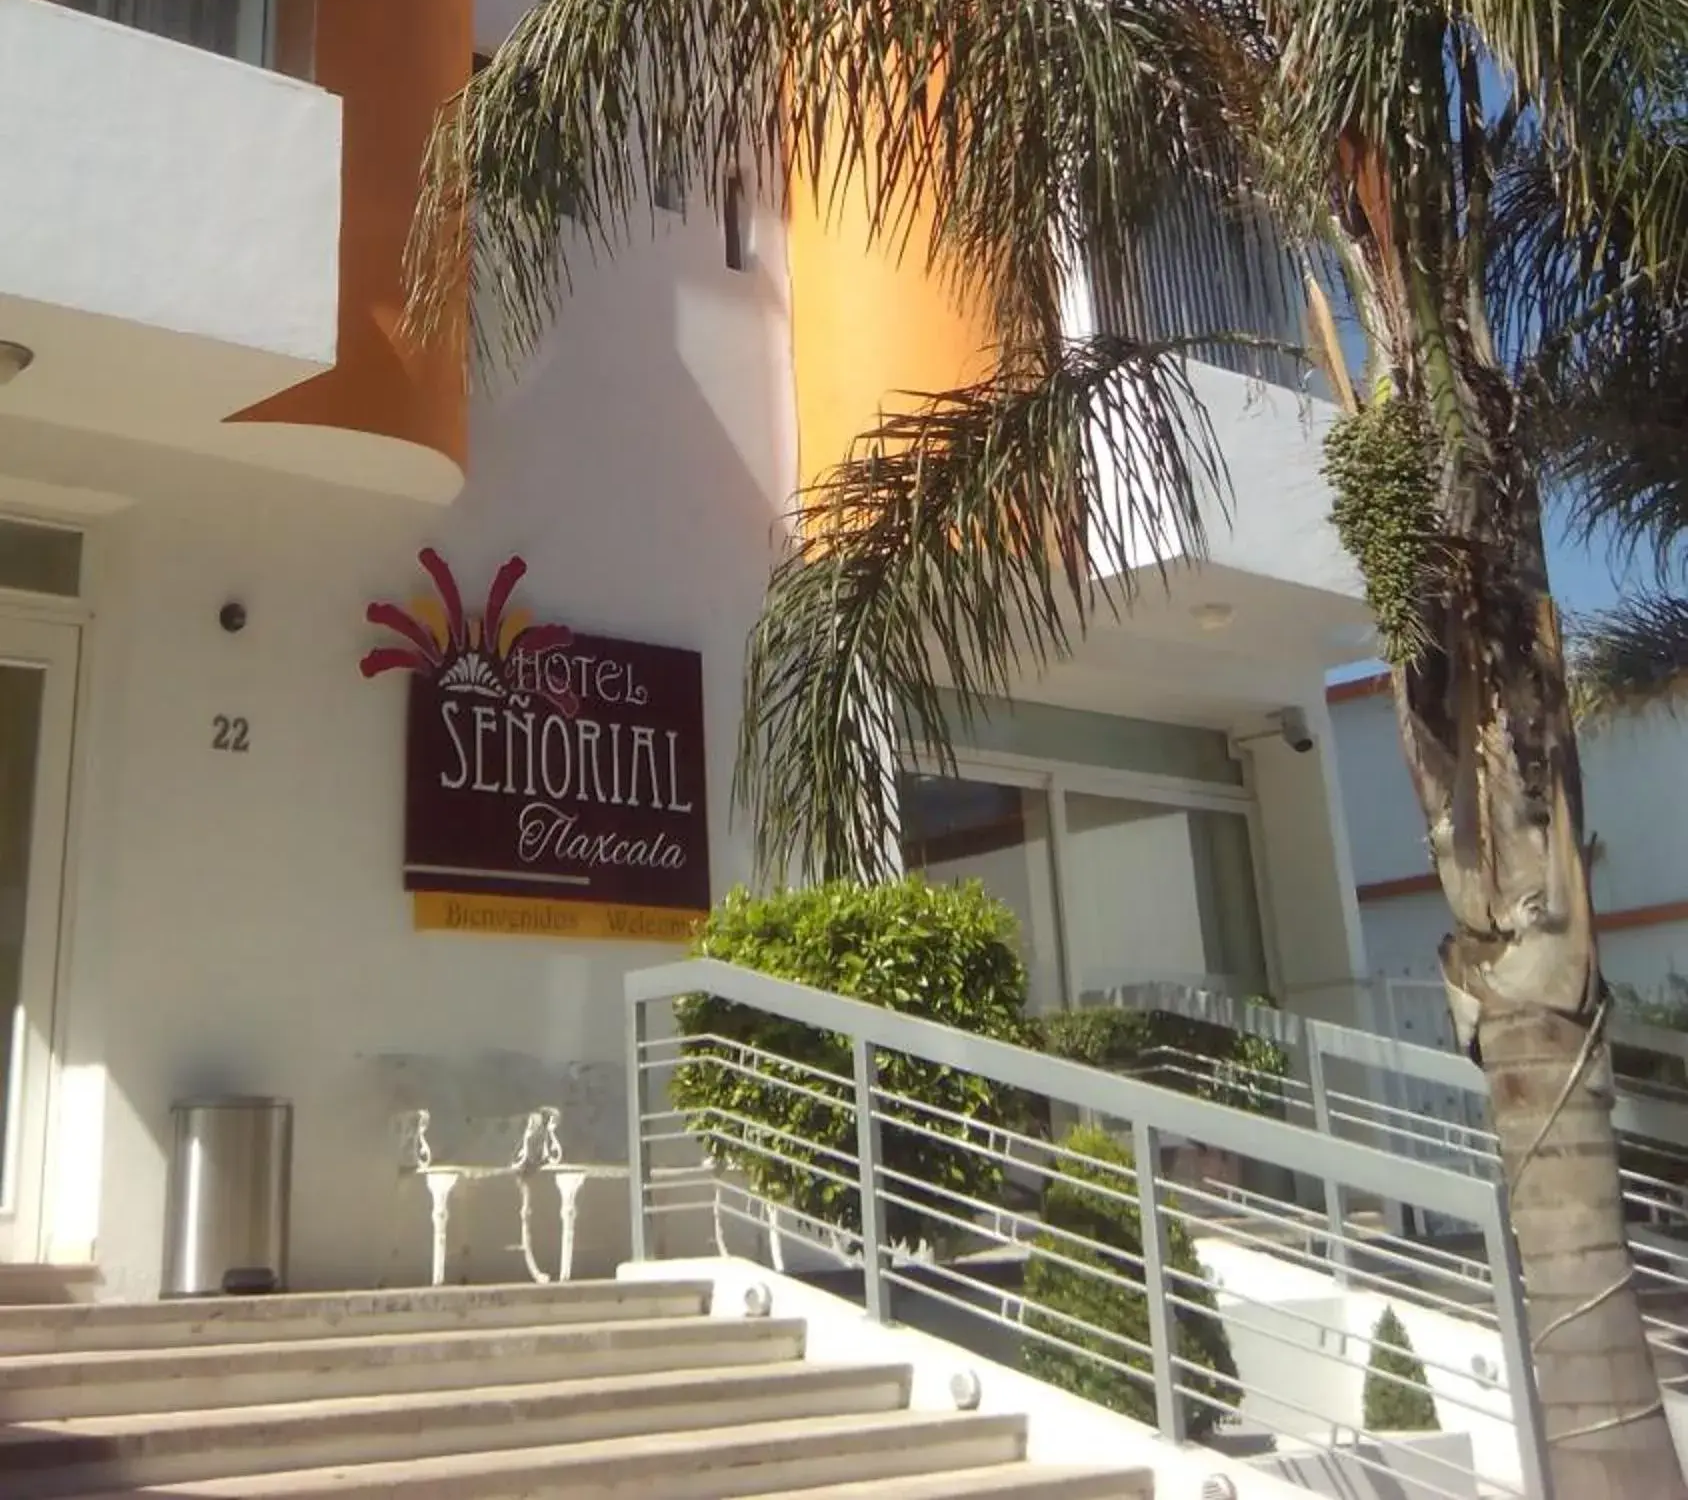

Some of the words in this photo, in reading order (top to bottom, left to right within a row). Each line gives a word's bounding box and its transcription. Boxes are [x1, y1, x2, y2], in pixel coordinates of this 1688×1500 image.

[508, 647, 648, 705] HOTEL
[213, 714, 250, 752] 22
[440, 694, 692, 812] SEÑORIAL
[518, 802, 686, 868] Tlaxcala
[445, 900, 579, 932] Bienvenidos
